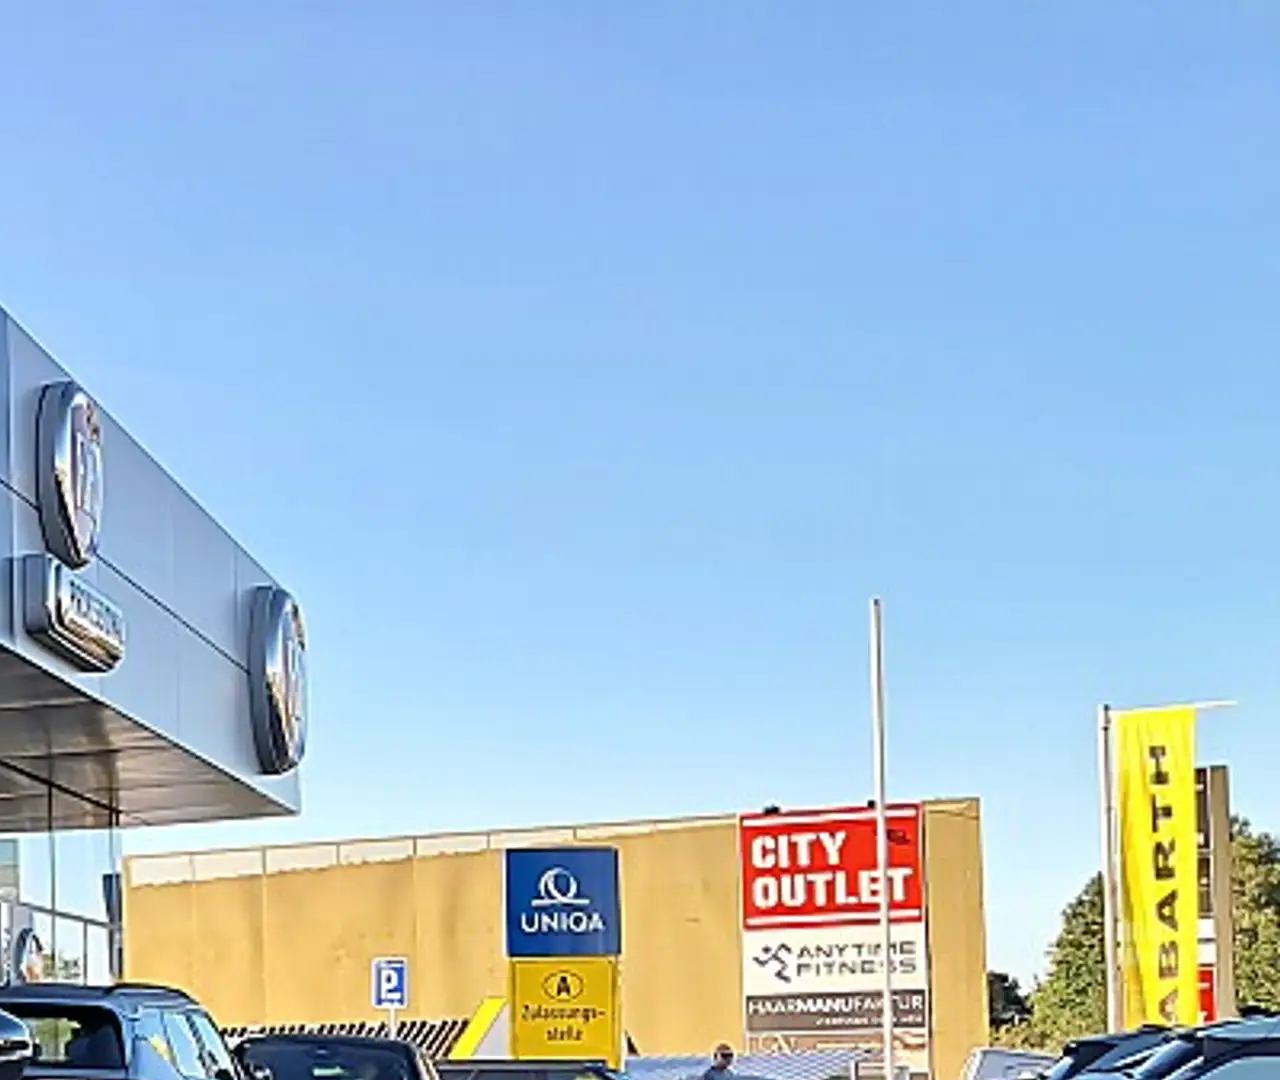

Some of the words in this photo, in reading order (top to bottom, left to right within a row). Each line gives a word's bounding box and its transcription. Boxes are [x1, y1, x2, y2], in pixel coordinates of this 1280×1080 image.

[750, 830, 846, 870] CITY
[751, 866, 913, 909] OUTLET
[1148, 745, 1180, 1023] ABARTH
[520, 911, 606, 934] UNIQA
